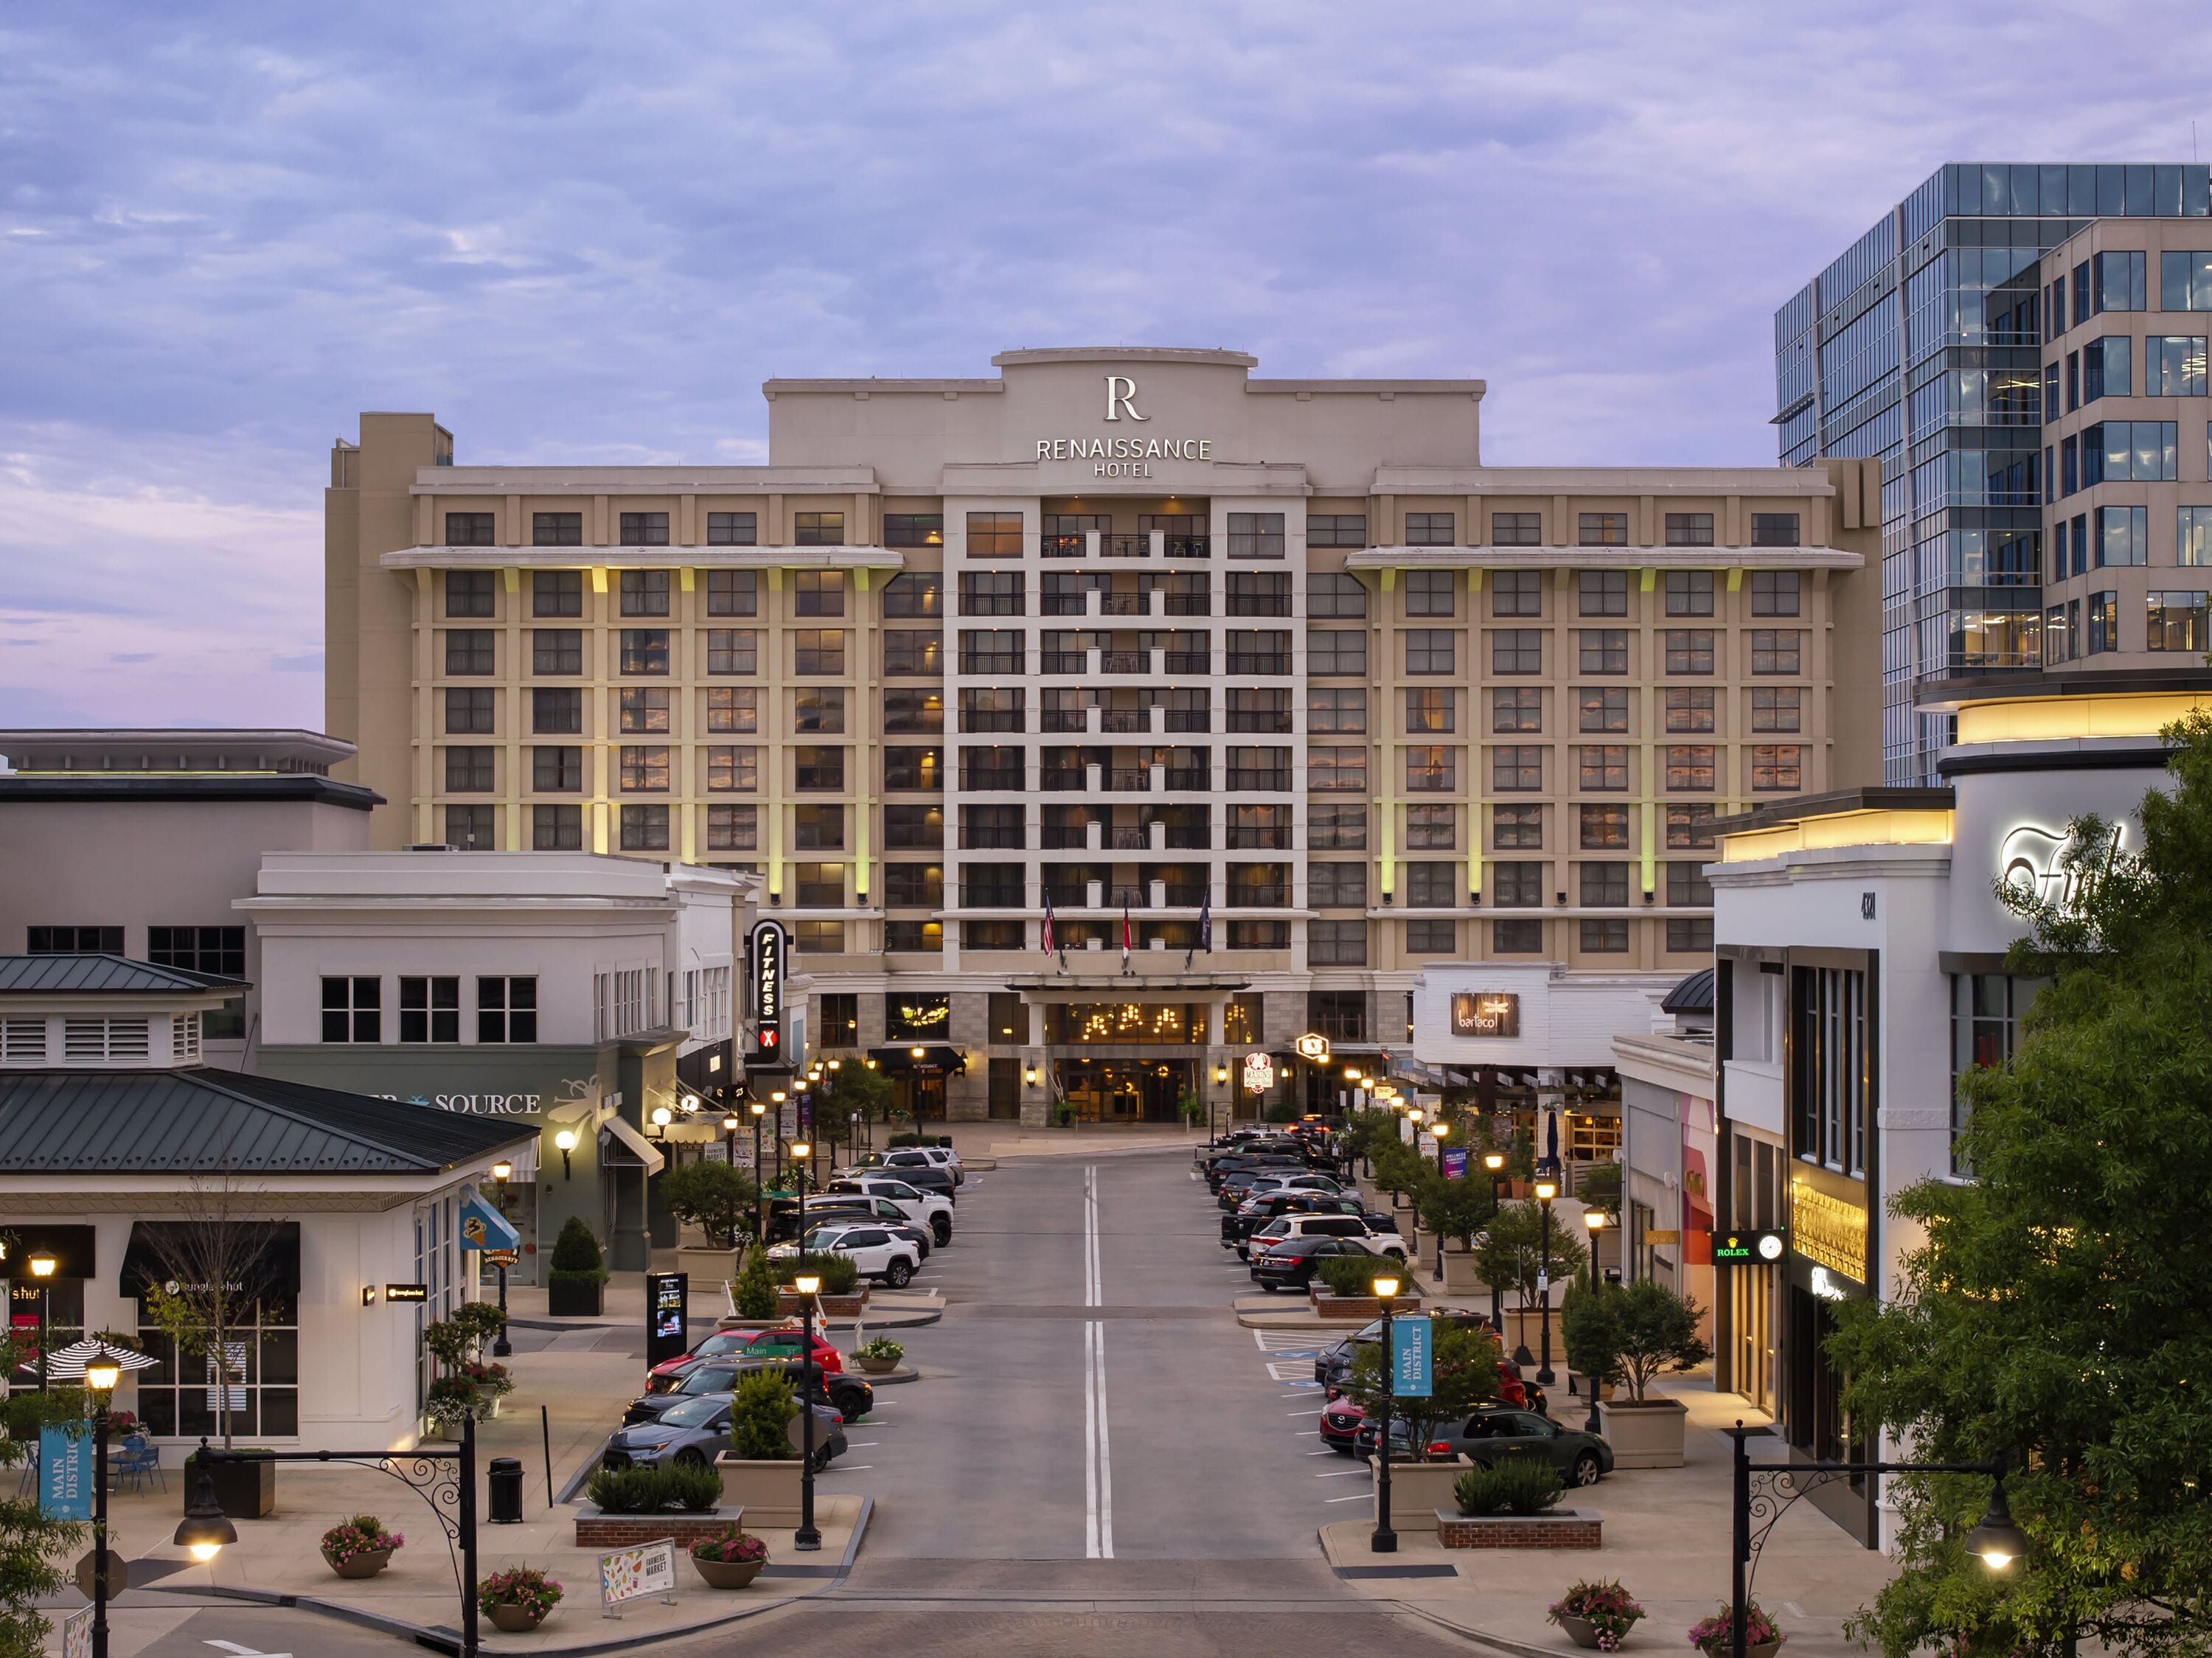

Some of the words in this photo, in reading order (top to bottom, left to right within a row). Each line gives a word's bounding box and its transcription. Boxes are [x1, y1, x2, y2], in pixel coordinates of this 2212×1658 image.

[1103, 376, 1151, 421] R
[1037, 438, 1211, 461] RENAISSANCE
[1094, 463, 1153, 478] HOTEL
[762, 933, 776, 1016] FITNESS
[1458, 1009, 1495, 1028] bartaco
[1246, 1070, 1271, 1079] MASON'S
[435, 1094, 541, 1115] SOURCE
[1717, 1248, 1750, 1257] ROLEX
[746, 1347, 767, 1355] Main
[1412, 1326, 1422, 1380] DISTRICT
[1402, 1348, 1412, 1380] MAIN
[66, 1435, 79, 1499] DISTRIC
[52, 1458, 65, 1499] MAIN
[646, 1561, 667, 1576] MARKET
